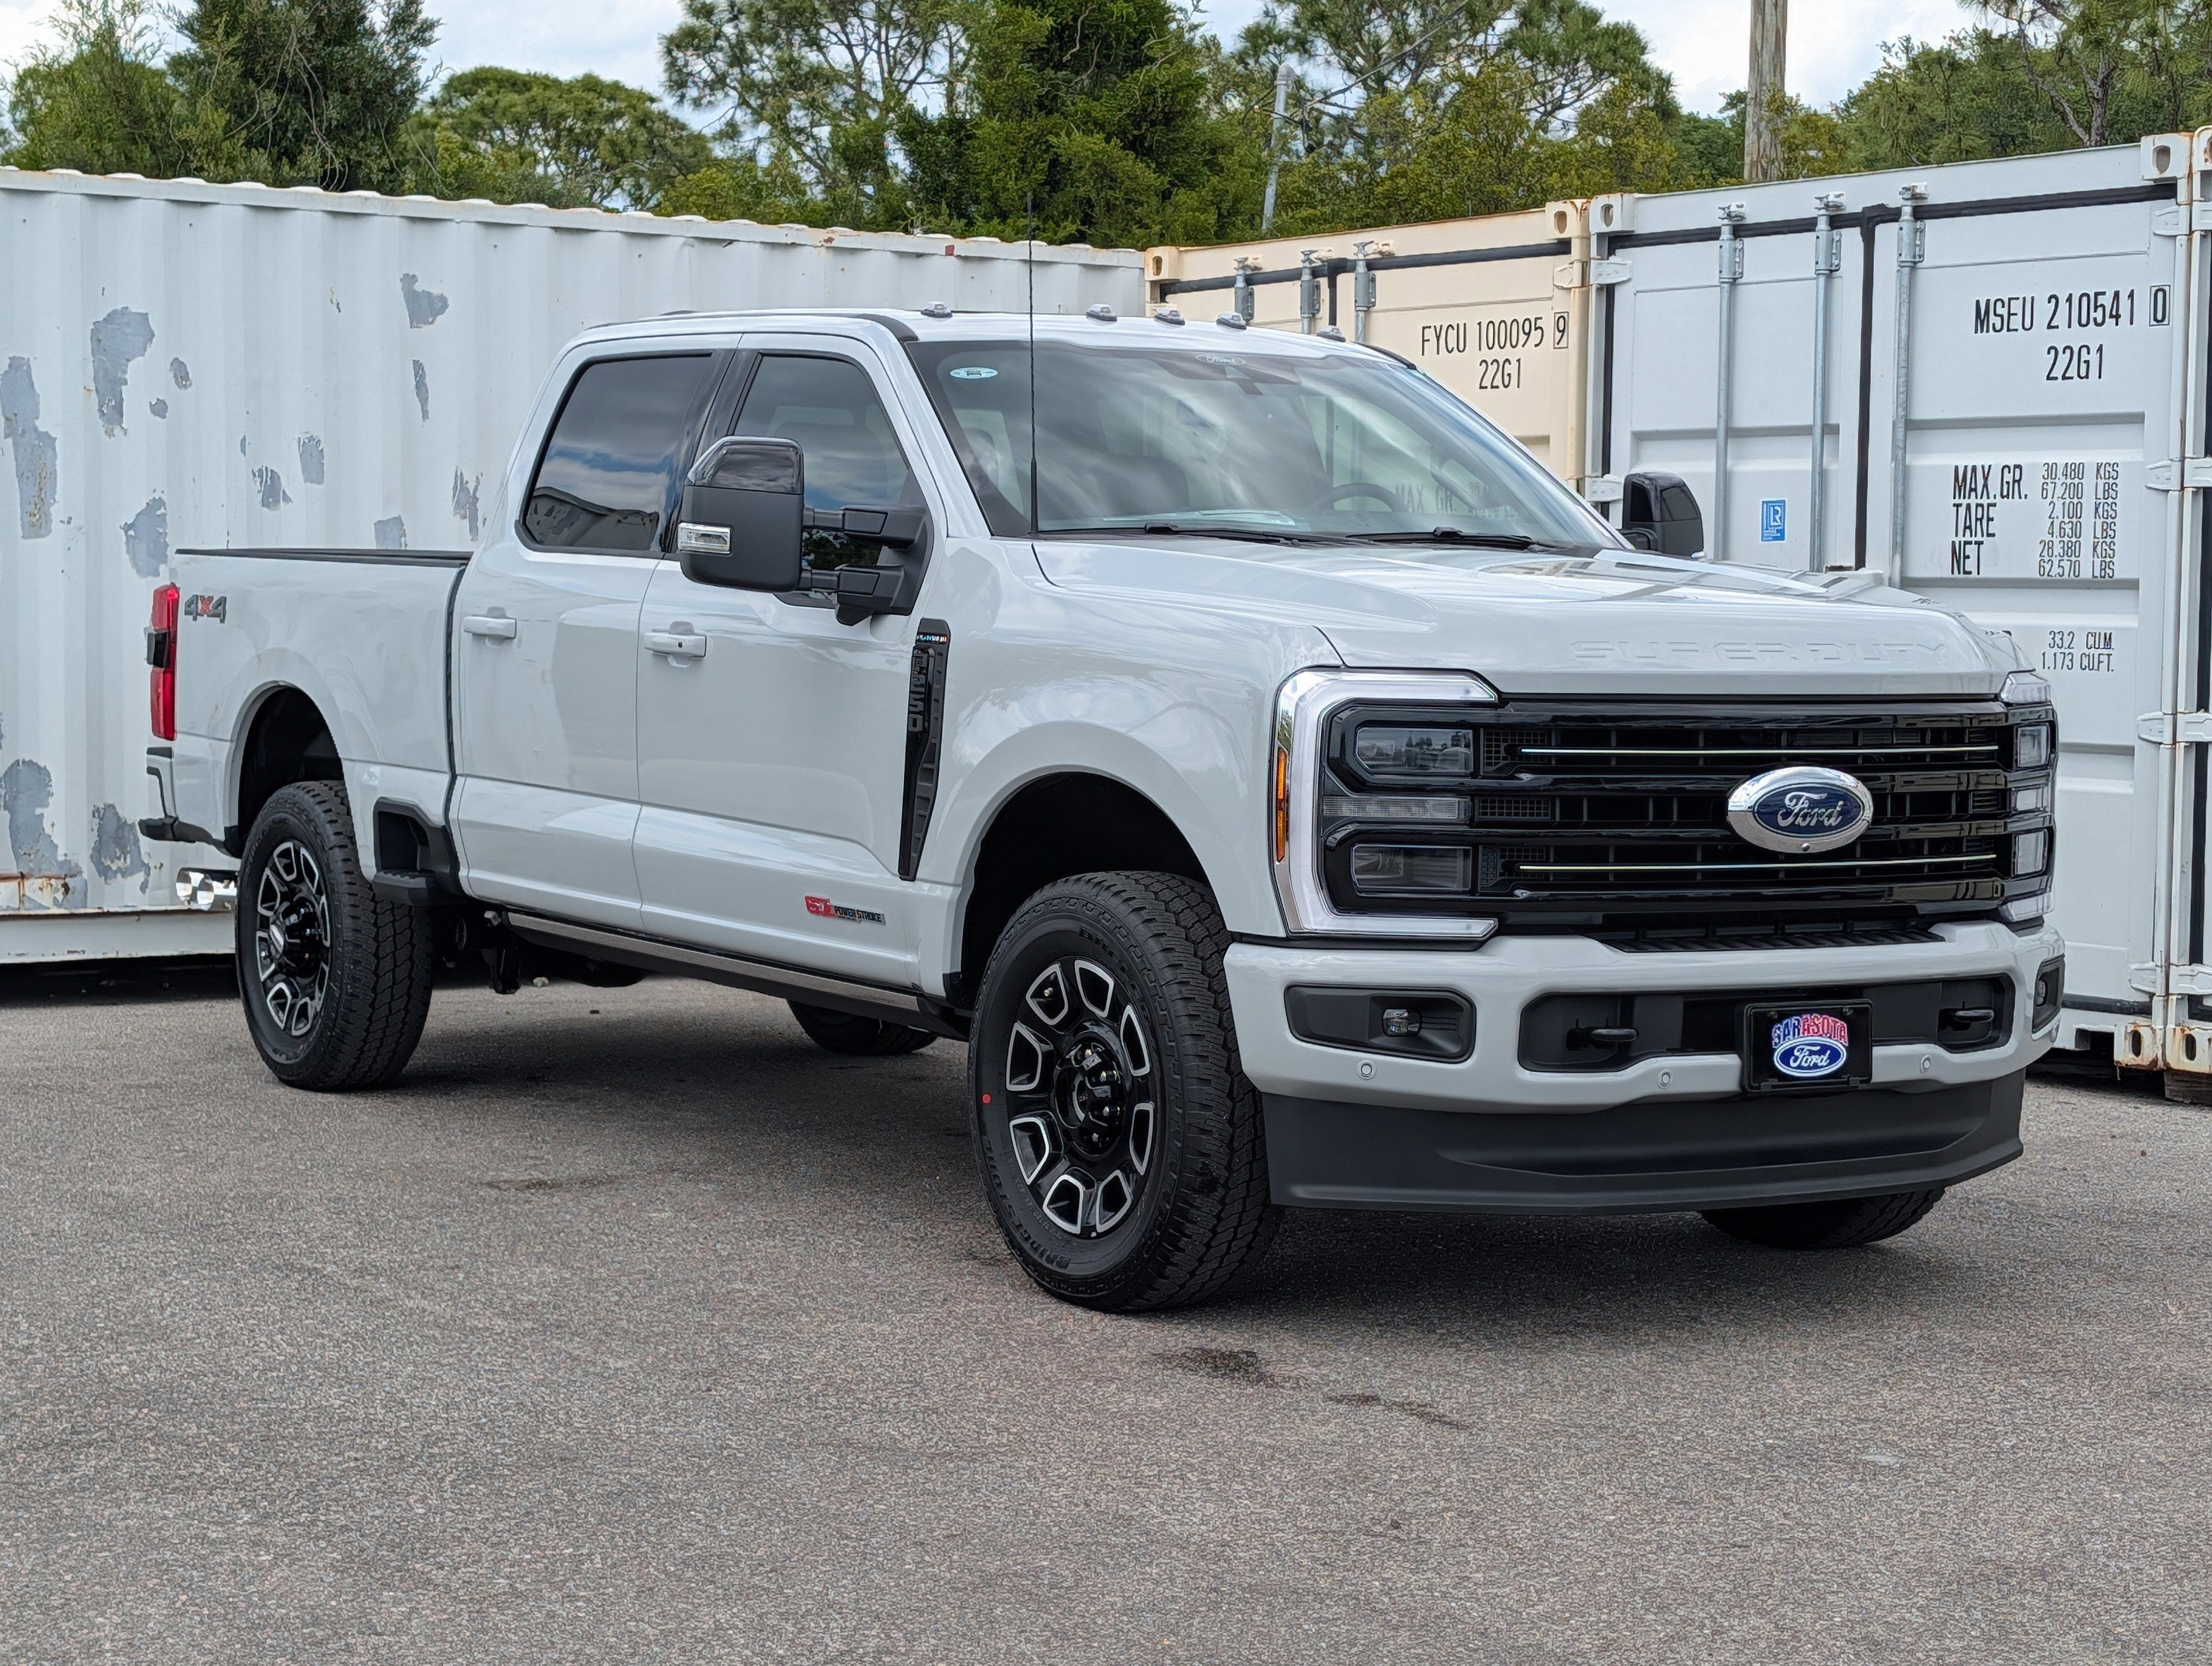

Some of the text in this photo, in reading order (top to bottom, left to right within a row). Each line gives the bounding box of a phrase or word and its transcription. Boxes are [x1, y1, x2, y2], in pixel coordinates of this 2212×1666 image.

[1974, 287, 2168, 334] MSEU 210541 0
[1420, 315, 1567, 356] FYCU 100095 9
[1478, 357, 1522, 390] 22G1
[2046, 343, 2104, 381] 22G1
[2042, 462, 2085, 480] 30.480
[2095, 462, 2119, 480] KGS
[2041, 482, 2118, 500] 67.200 LBS
[1952, 501, 2118, 538] TARE 2.100 KGS
[2047, 520, 2117, 539] 4.630 LBS
[1951, 539, 2116, 575] NET 28.380 KGS
[2037, 558, 2115, 579] 62.570 LBS
[2042, 651, 2074, 670] 1.173
[1777, 791, 1844, 828] Ford
[834, 905, 857, 918] POWER
[856, 909, 882, 922] STROKE
[1771, 1013, 1849, 1049] SARASOTA
[1789, 1045, 1831, 1067] Ford
